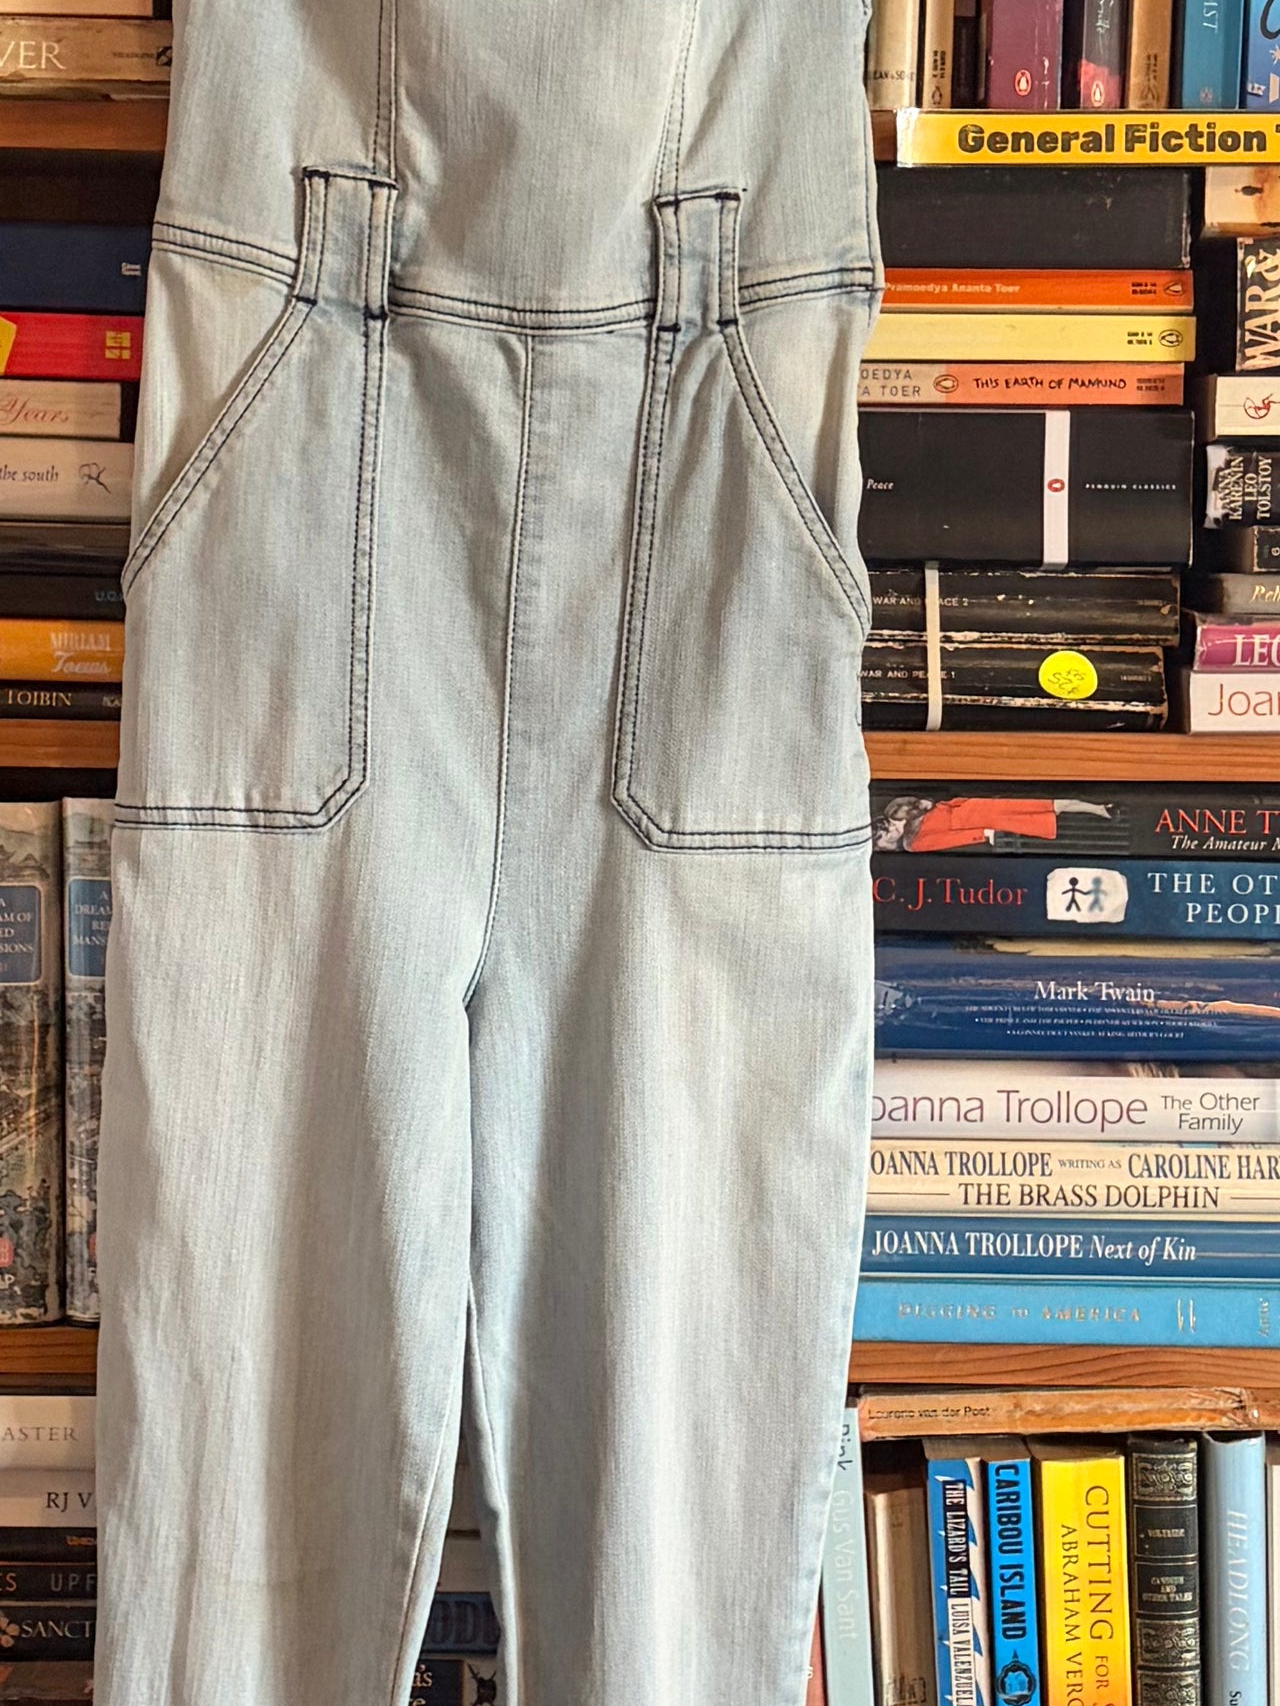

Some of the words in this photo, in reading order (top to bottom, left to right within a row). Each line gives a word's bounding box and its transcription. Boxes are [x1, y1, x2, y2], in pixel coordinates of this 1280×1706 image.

[959, 125, 1113, 154] General
[1124, 125, 1266, 153] Fiction
[1147, 873, 1222, 897] THE
[994, 1463, 1024, 1556] CARIBOU
[999, 1564, 1029, 1641] ISLAND
